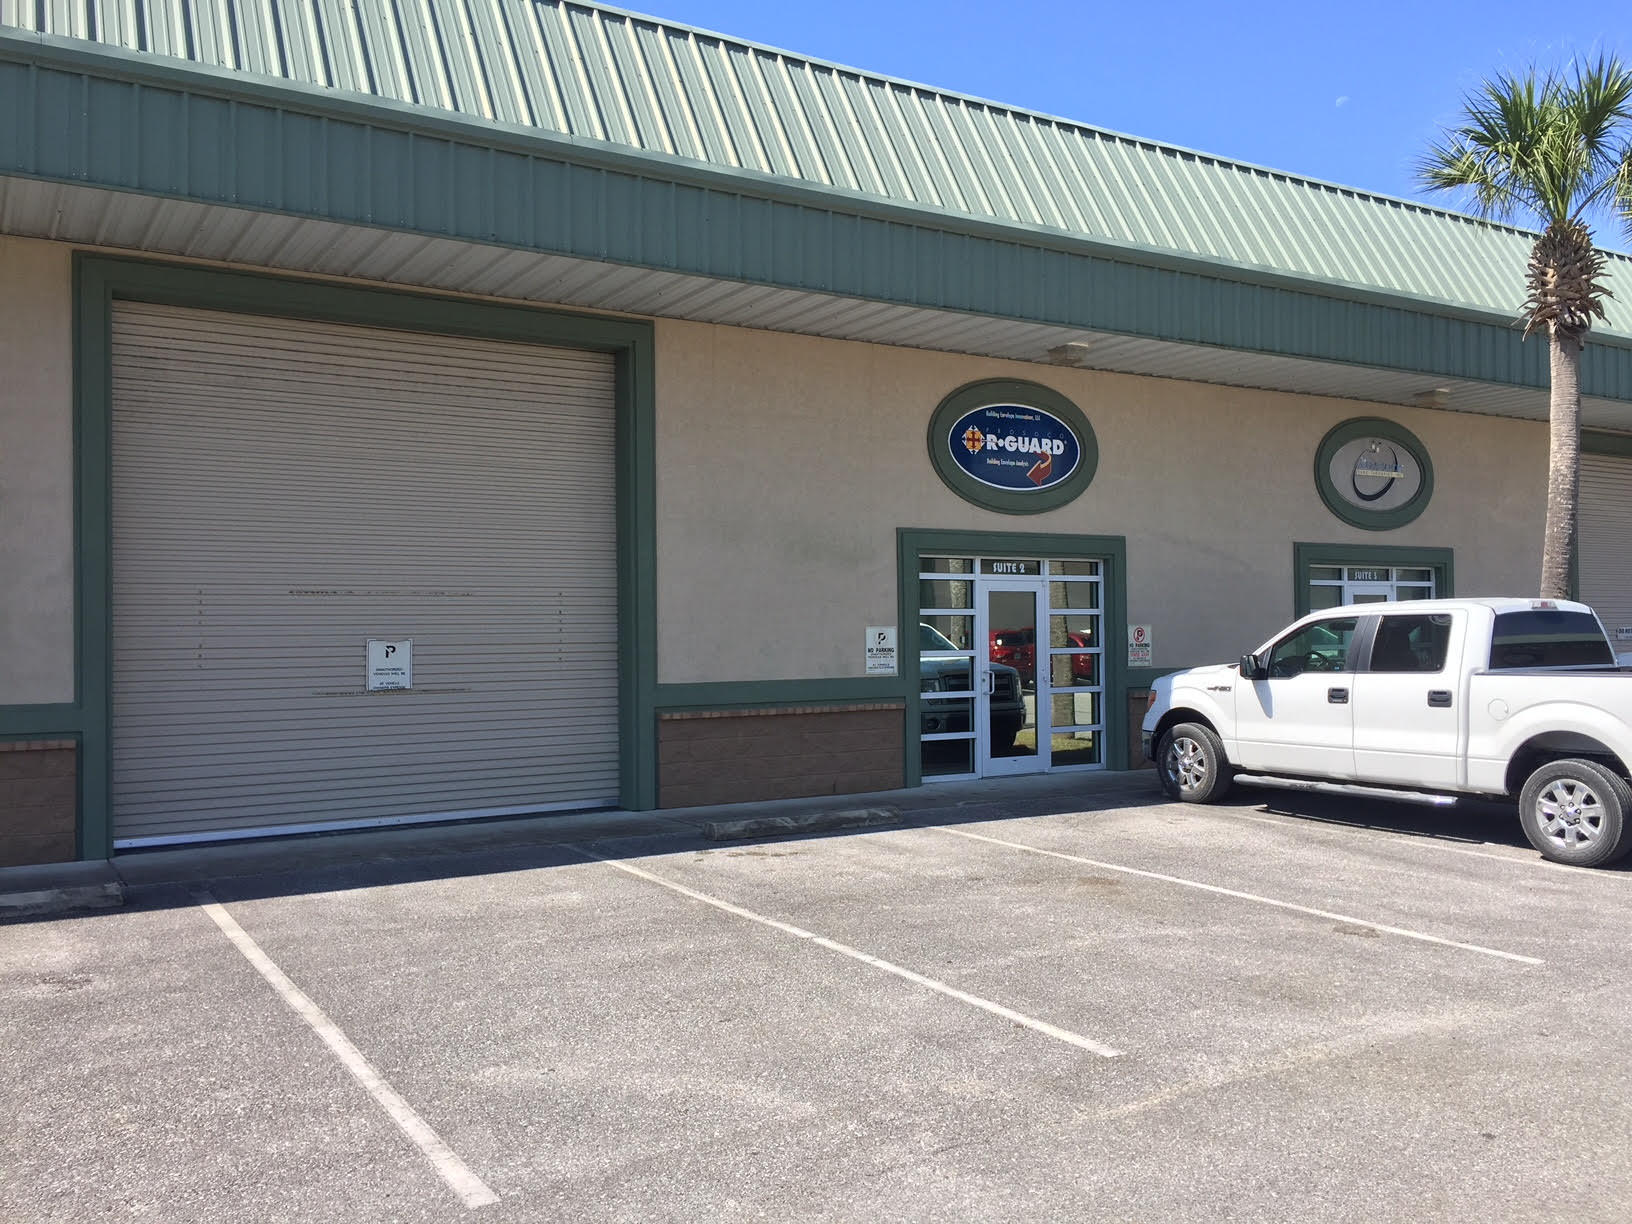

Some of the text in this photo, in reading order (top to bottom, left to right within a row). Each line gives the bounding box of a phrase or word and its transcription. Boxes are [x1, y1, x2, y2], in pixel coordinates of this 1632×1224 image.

[993, 562, 1025, 573] SUITE 2
[1354, 571, 1372, 580] SUITE
